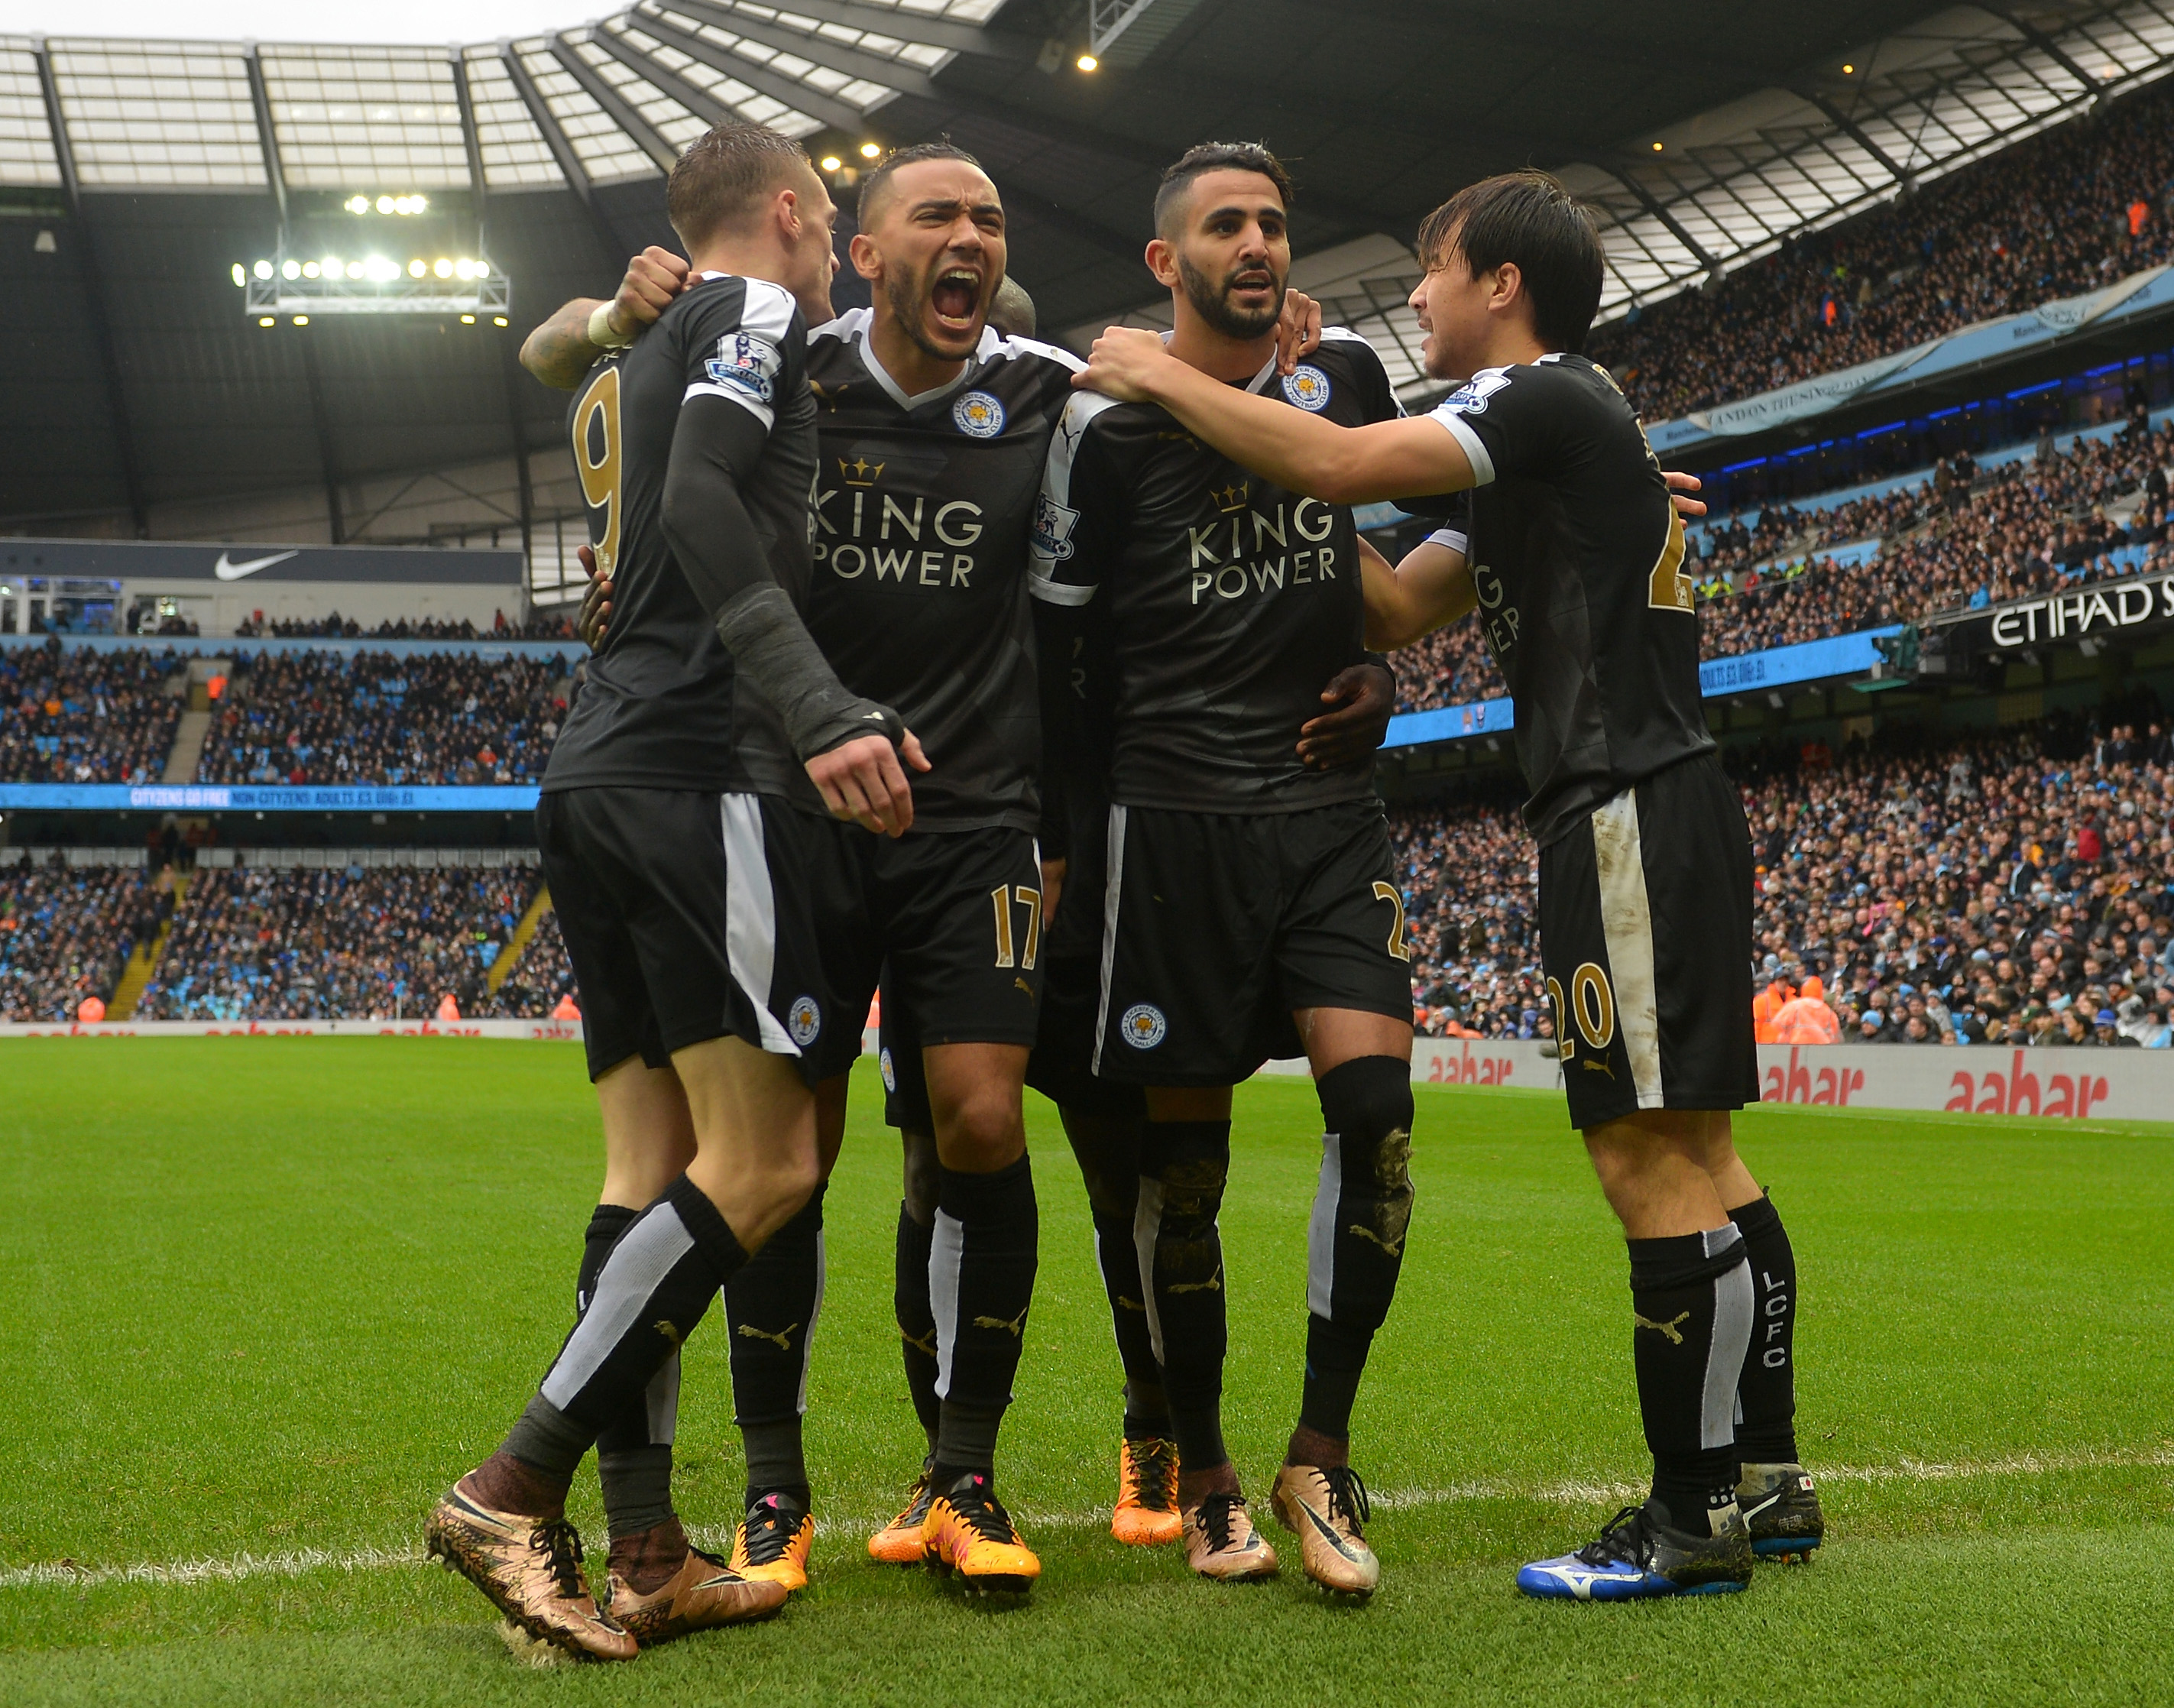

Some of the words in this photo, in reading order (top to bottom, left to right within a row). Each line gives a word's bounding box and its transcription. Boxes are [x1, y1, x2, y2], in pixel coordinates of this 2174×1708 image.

[954, 393, 986, 413] LEICESTER
[986, 397, 1000, 412] CITY
[1288, 391, 1321, 408] FOOTBALL
[1319, 385, 1327, 404] CLUB
[1311, 370, 1325, 382] CITY
[955, 416, 992, 436] FOOTBALL
[990, 414, 1001, 433] CLUB
[572, 365, 622, 581] 9
[815, 489, 983, 548] KING
[1188, 496, 1333, 569] KING
[813, 542, 974, 588] POWER
[1191, 539, 1336, 605] POWER
[1991, 582, 2154, 647] ETIHAD
[990, 883, 1042, 971] 17
[1372, 880, 1411, 964] 2
[1546, 961, 1615, 1063] 20
[1762, 1271, 1788, 1369] LCFC
